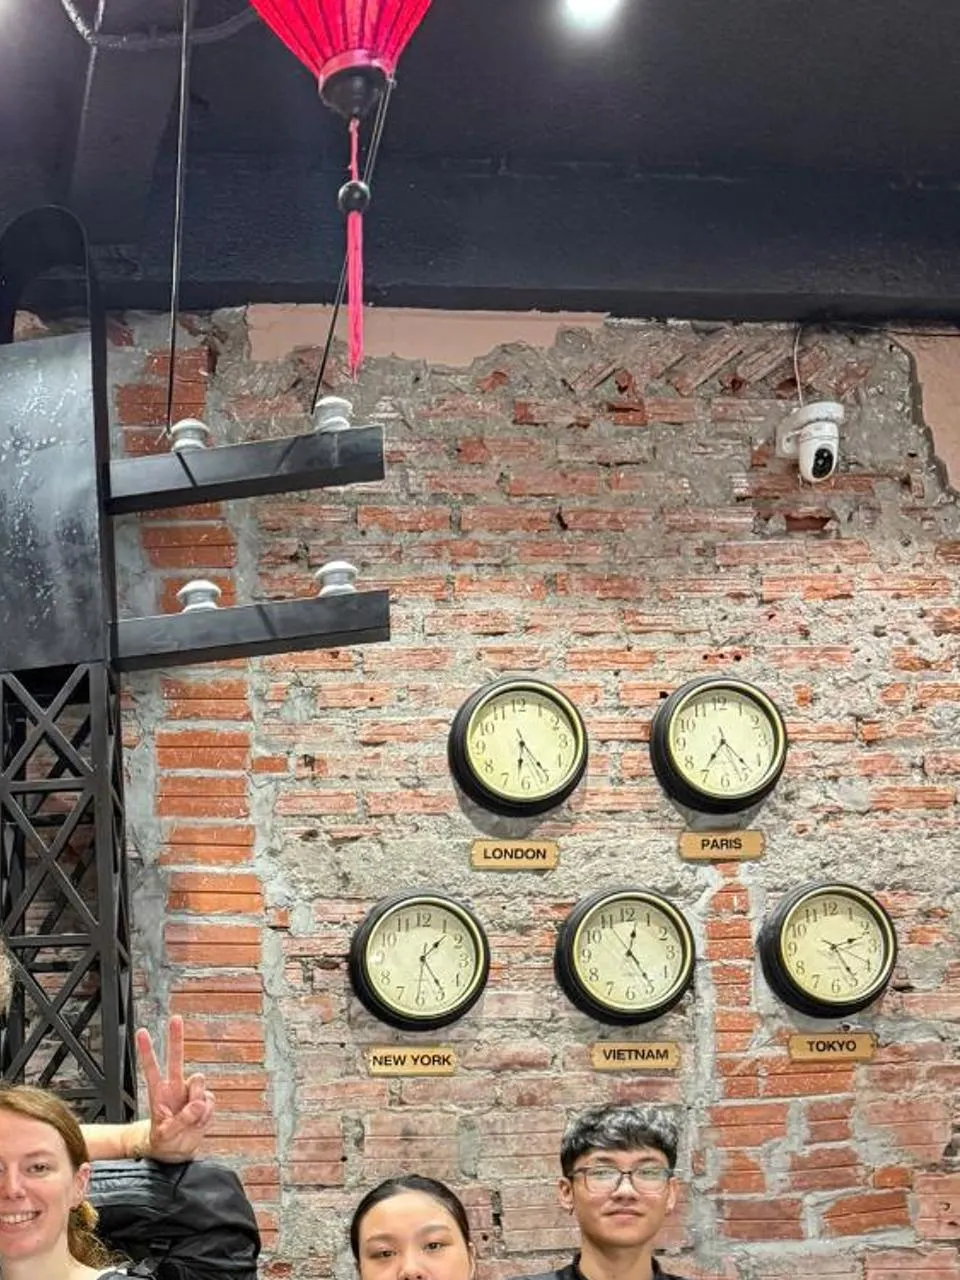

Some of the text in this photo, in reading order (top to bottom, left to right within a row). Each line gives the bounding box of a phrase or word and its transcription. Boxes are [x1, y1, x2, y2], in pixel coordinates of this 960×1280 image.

[701, 837, 742, 850] PARIS
[483, 847, 547, 861] LONDON
[621, 908, 635, 921] 12
[805, 909, 817, 922] 11
[823, 902, 838, 916] 12
[416, 913, 431, 927] 12
[601, 915, 613, 928] 11
[587, 930, 601, 944] 10
[659, 927, 668, 941] 2
[791, 924, 806, 938] 10
[382, 932, 397, 947] 10
[454, 934, 463, 949] 2
[582, 949, 592, 963] 9
[666, 945, 675, 959] 3
[788, 942, 797, 957] 9
[589, 968, 598, 981] 8
[796, 961, 805, 974] 8
[381, 970, 390, 985] 8
[812, 974, 820, 988] 7
[396, 986, 404, 1000] 7
[606, 981, 614, 996] 7
[832, 979, 840, 993] 6
[626, 987, 635, 1000] 6
[807, 1040, 857, 1052] TOKYO
[372, 1054, 452, 1066] NEW YORK
[602, 1048, 669, 1061] VIETNAM
